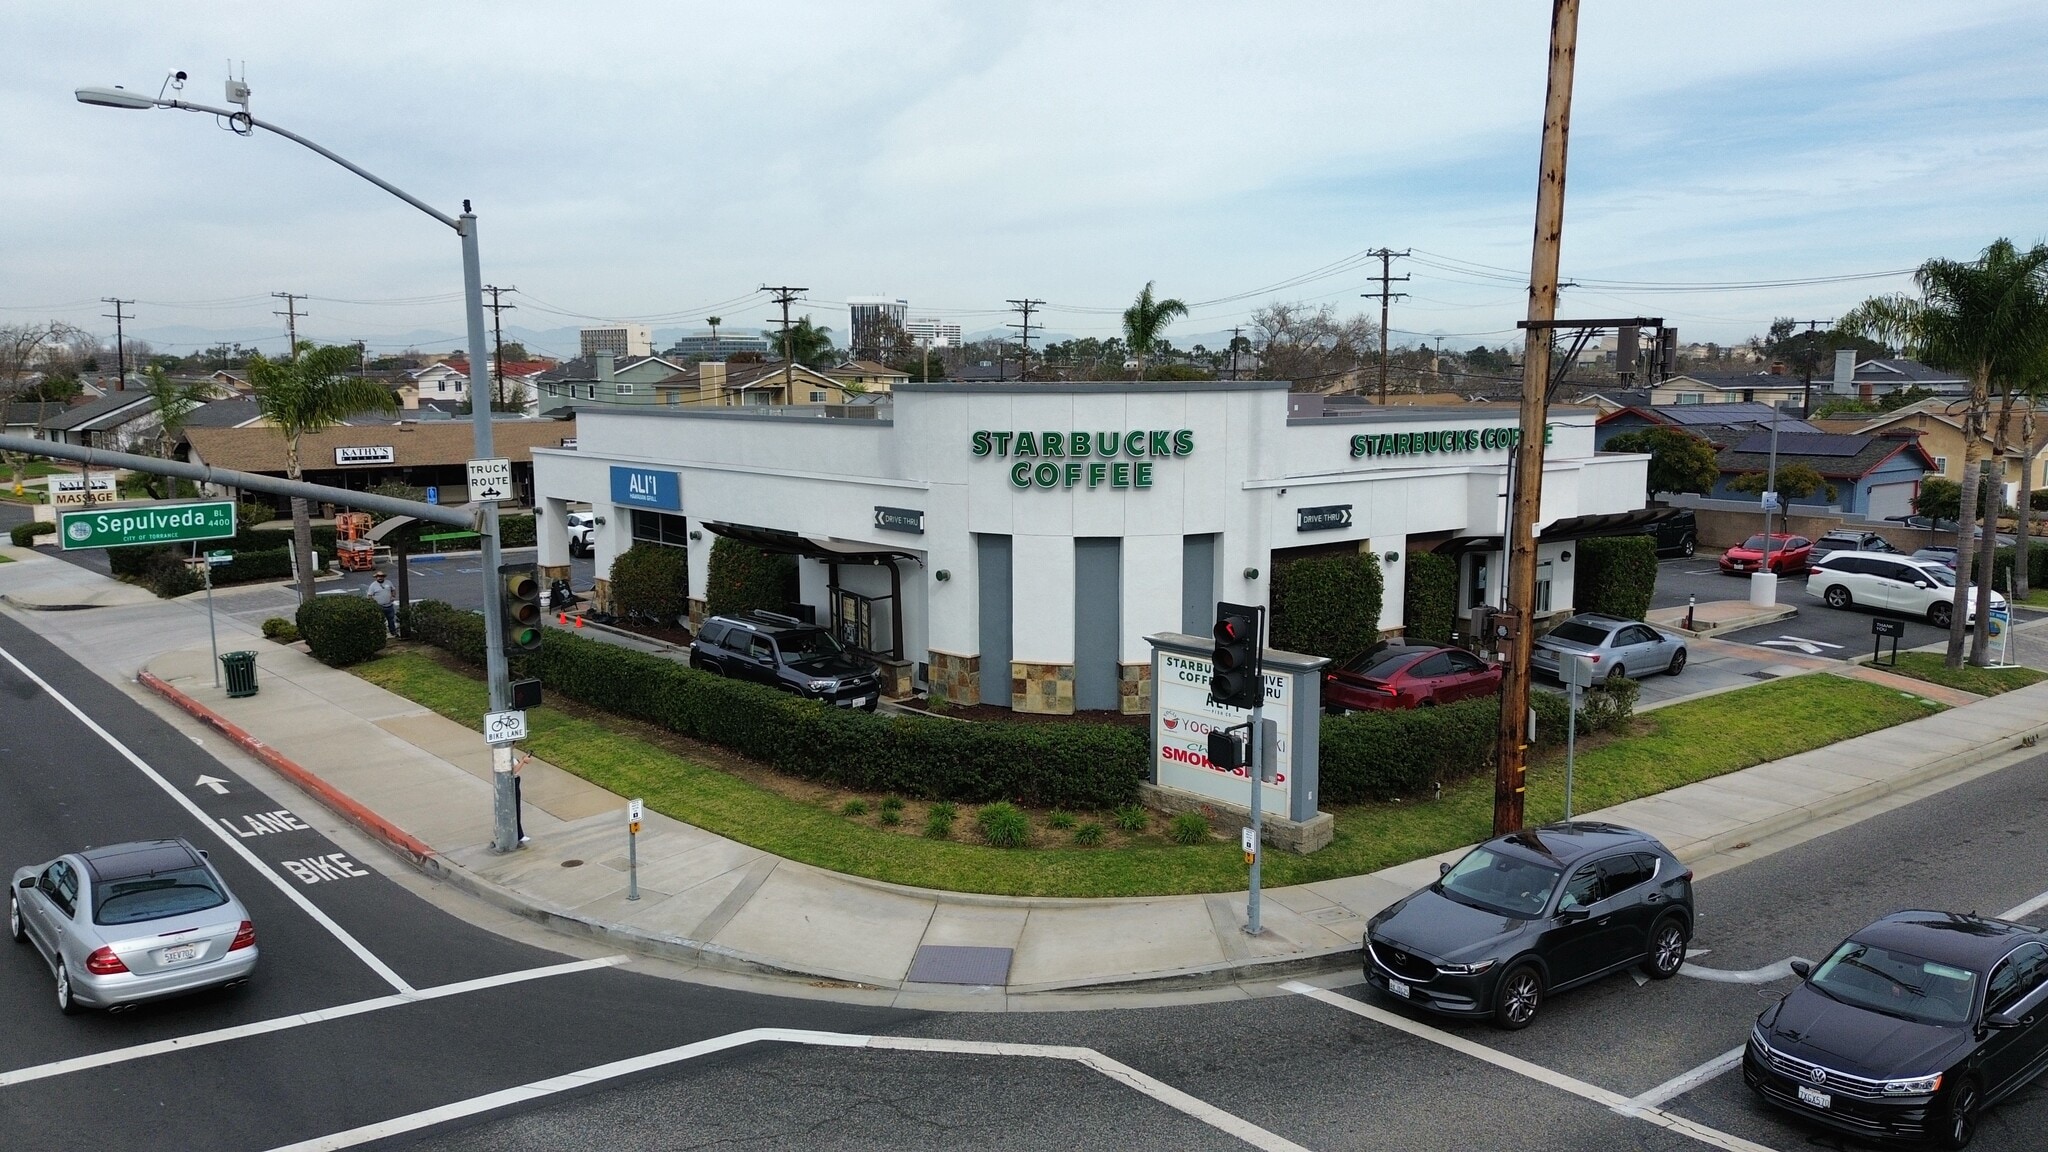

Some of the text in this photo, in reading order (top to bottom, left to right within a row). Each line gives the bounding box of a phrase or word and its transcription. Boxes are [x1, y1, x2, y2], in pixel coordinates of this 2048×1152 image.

[971, 429, 1195, 457] STARBUCKS
[1351, 426, 1553, 458] STARBUCKS COFE
[342, 448, 388, 456] KATHY'S
[470, 464, 508, 474] TRUCK
[1010, 461, 1153, 488] COFFEE
[471, 477, 509, 486] ROUTE
[96, 510, 204, 535] Sepulveda
[208, 519, 230, 527] 4400
[885, 515, 919, 526] DRIVE THRU
[1303, 513, 1340, 524] DRIVE THRU
[1166, 656, 1283, 687] STARBU IVE
[1266, 687, 1281, 699] RU
[507, 729, 523, 738] LANE
[219, 810, 310, 838] LANE
[281, 853, 370, 884] BIKE
